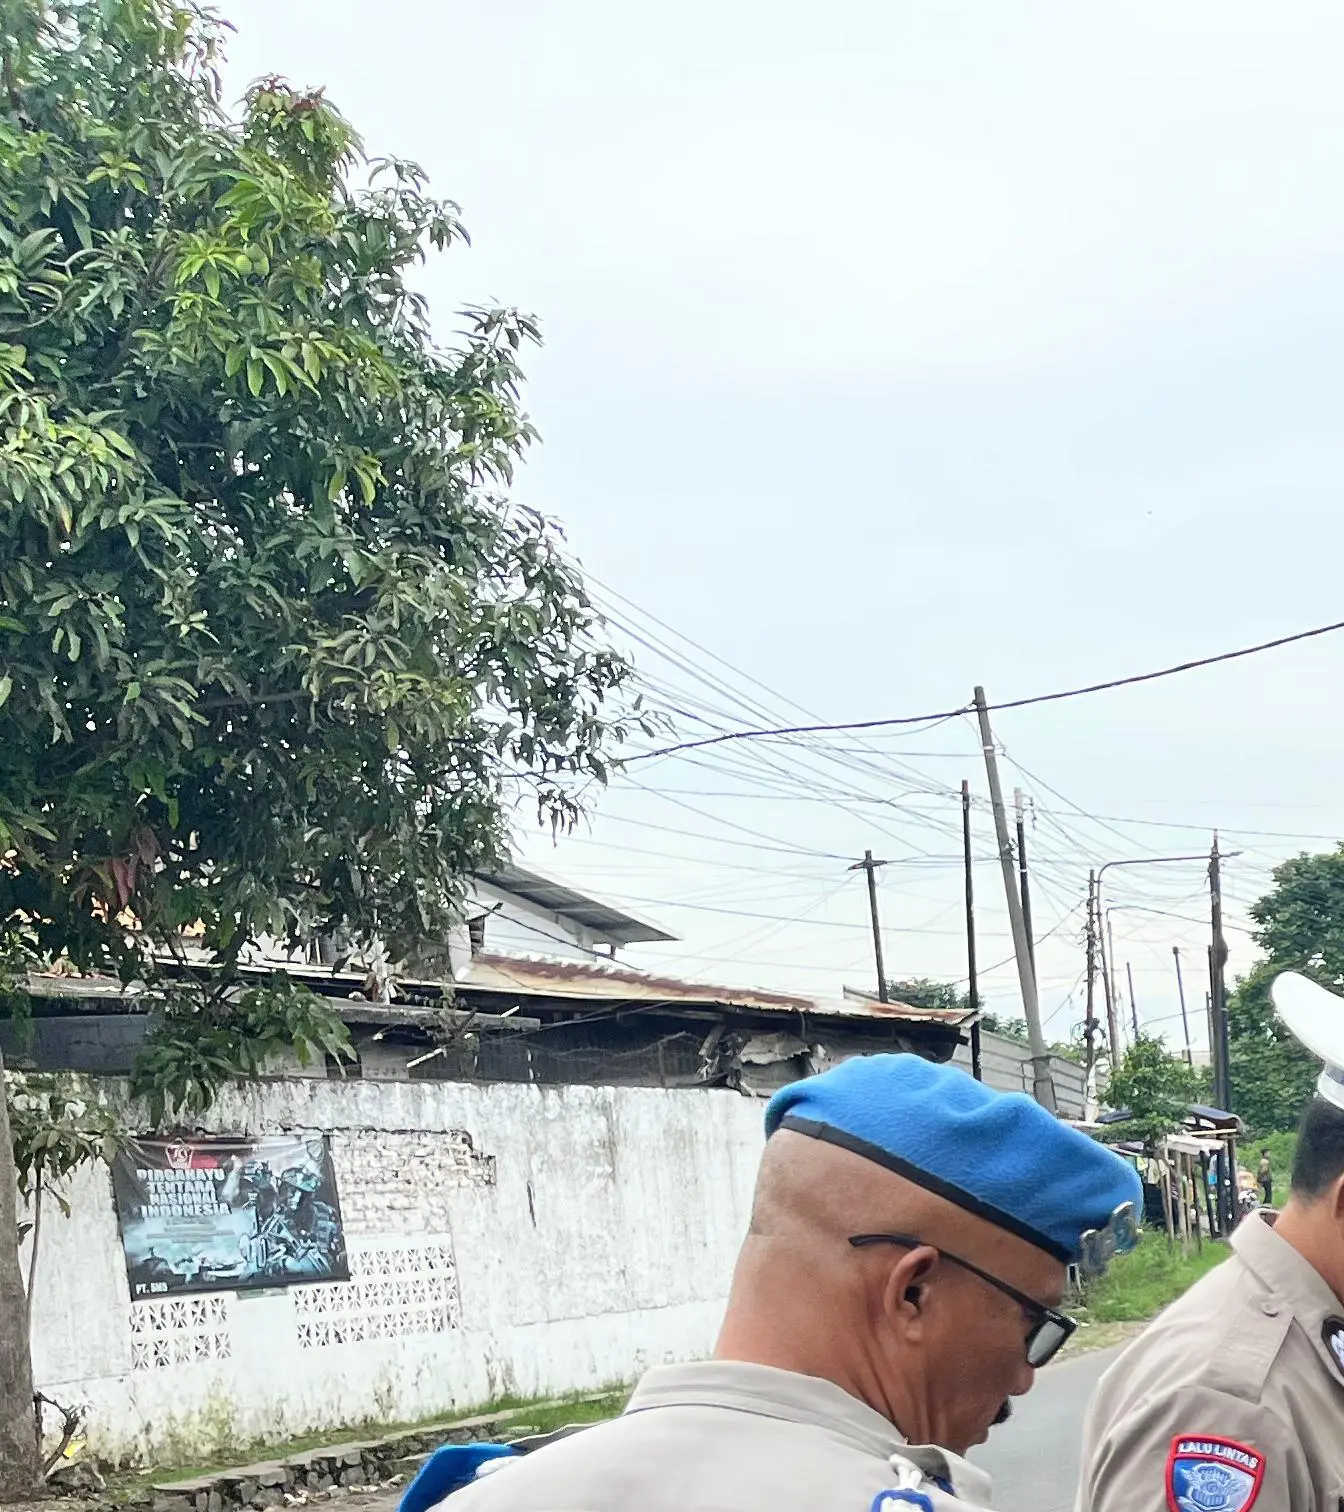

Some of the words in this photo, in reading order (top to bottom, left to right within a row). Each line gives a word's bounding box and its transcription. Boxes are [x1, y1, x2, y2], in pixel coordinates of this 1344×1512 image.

[147, 1180, 216, 1194] TENTARA
[149, 1192, 218, 1205] NASIONAL
[141, 1203, 231, 1218] INDONESIA
[1178, 1441, 1212, 1456] LALU
[1214, 1444, 1259, 1470] LINTAS
